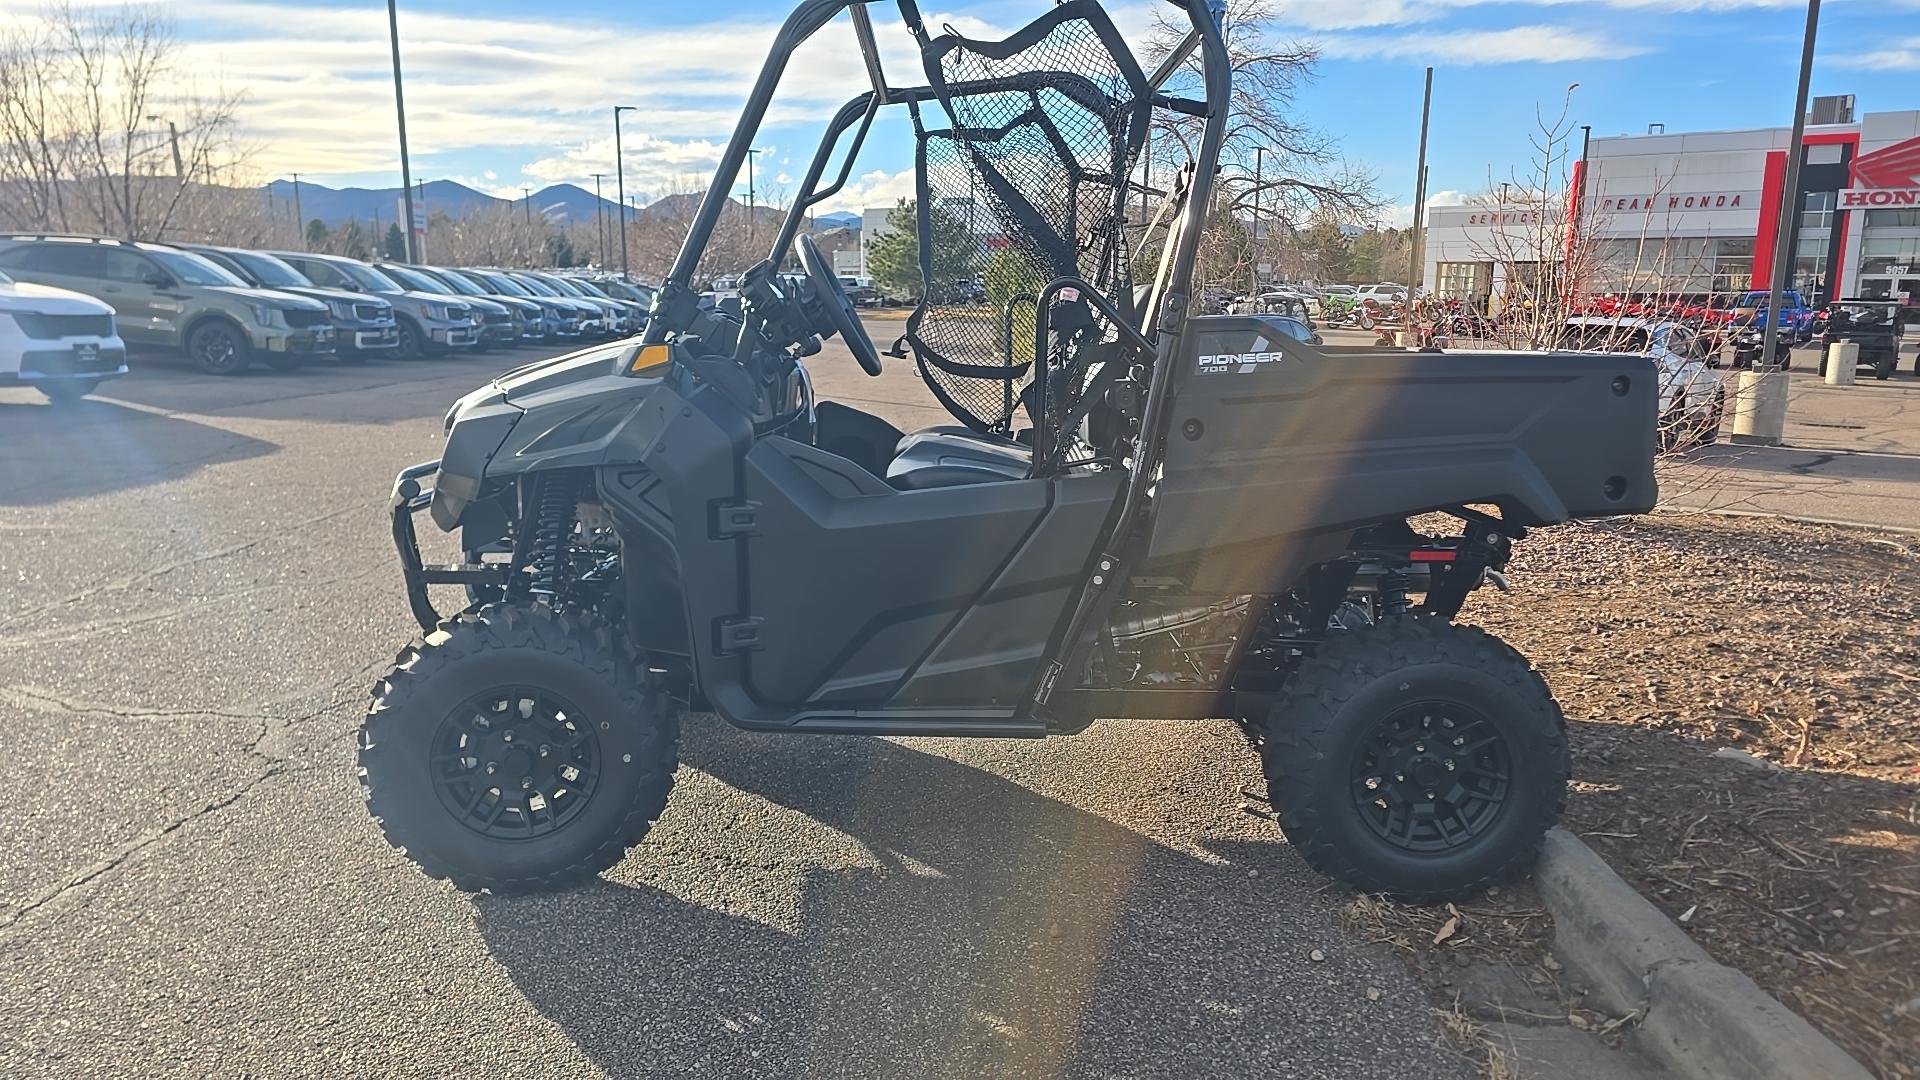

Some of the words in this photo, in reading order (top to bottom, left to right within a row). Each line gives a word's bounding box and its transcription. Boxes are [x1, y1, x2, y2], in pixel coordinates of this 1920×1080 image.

[1668, 195, 1741, 208] HONDA
[1843, 190, 1920, 206] HON
[1886, 265, 1909, 274] 5057
[1198, 352, 1283, 366] PIONEER
[1200, 365, 1228, 373] 700
